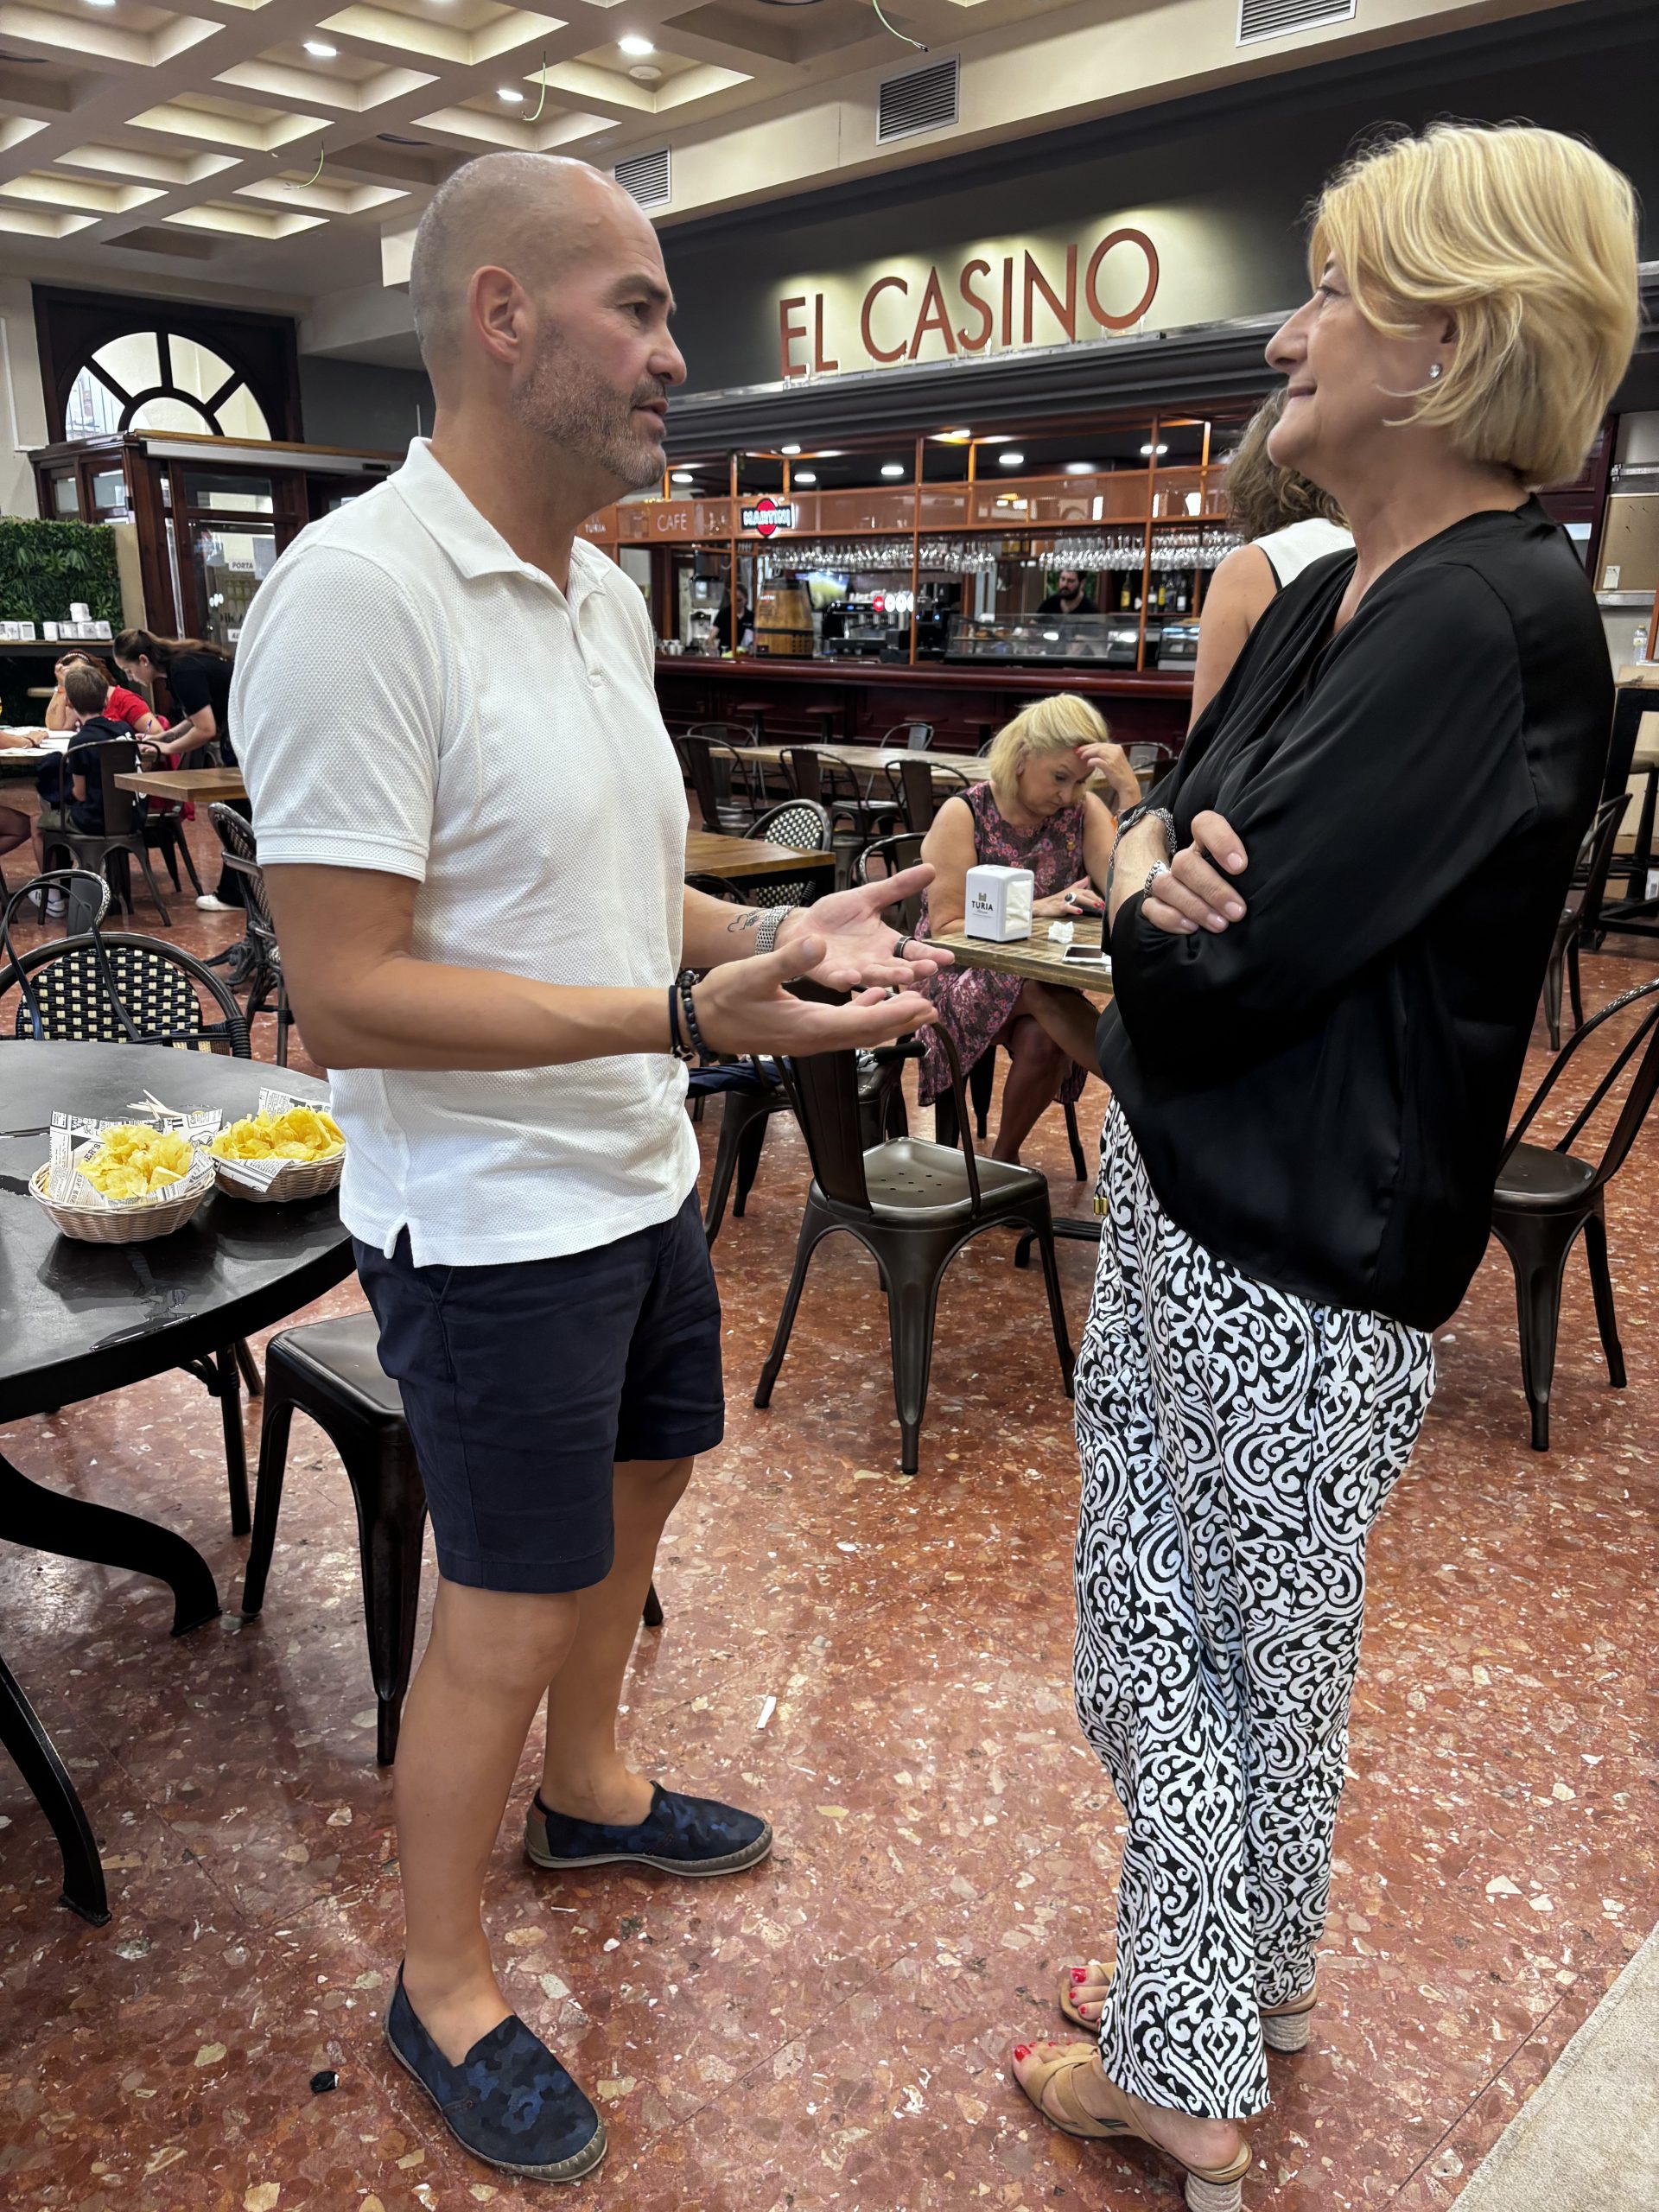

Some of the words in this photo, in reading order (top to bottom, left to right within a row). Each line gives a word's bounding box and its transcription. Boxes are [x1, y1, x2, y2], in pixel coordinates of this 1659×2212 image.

[779, 294, 839, 377] EL
[860, 228, 1160, 363] CASINO
[971, 901, 993, 911] TURIA
[84, 1143, 101, 1162] ER'S
